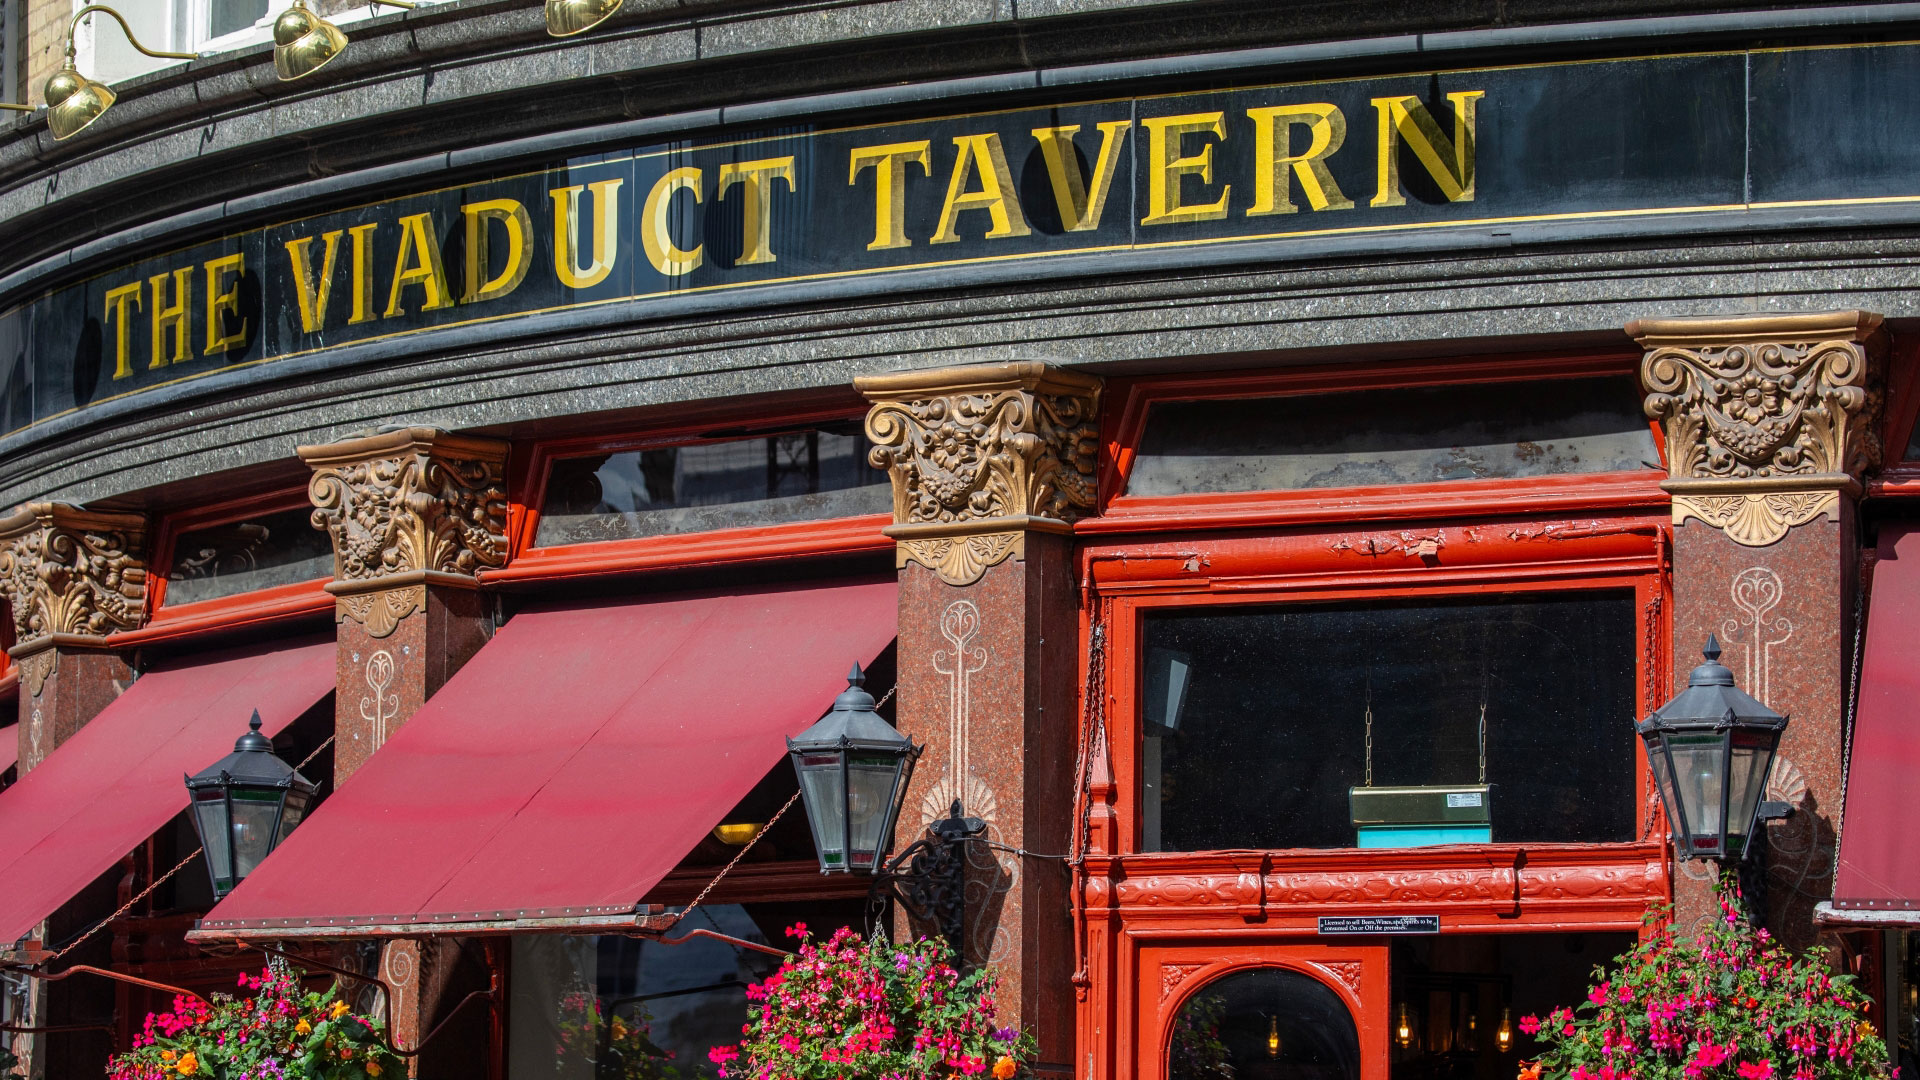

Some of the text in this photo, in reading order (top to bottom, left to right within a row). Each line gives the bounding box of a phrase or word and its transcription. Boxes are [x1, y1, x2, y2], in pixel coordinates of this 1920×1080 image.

[103, 90, 1486, 381] THE VIADUCT TAVERN
